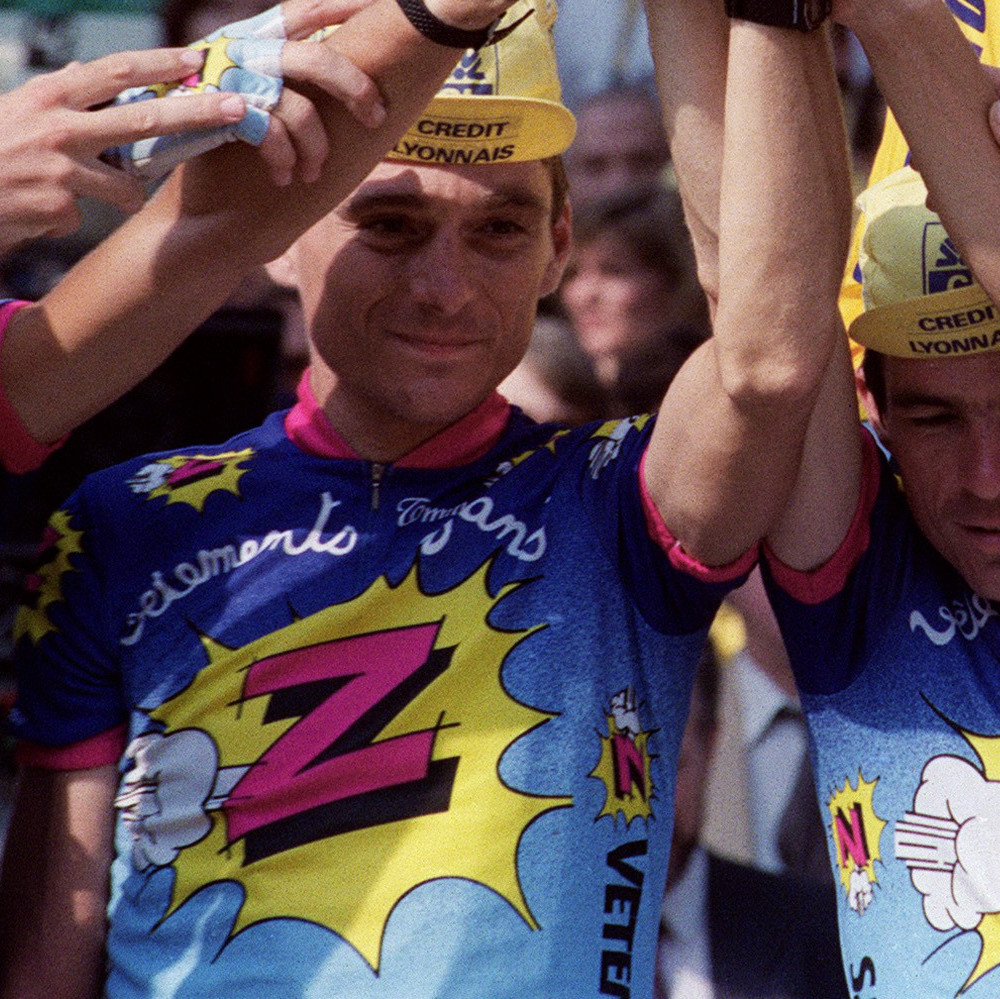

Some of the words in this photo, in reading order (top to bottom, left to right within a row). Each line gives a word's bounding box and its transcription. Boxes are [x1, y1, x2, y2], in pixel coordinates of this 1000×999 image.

[417, 120, 509, 137] CREDIT
[918, 306, 994, 331] CREDI
[222, 615, 461, 867] Z
